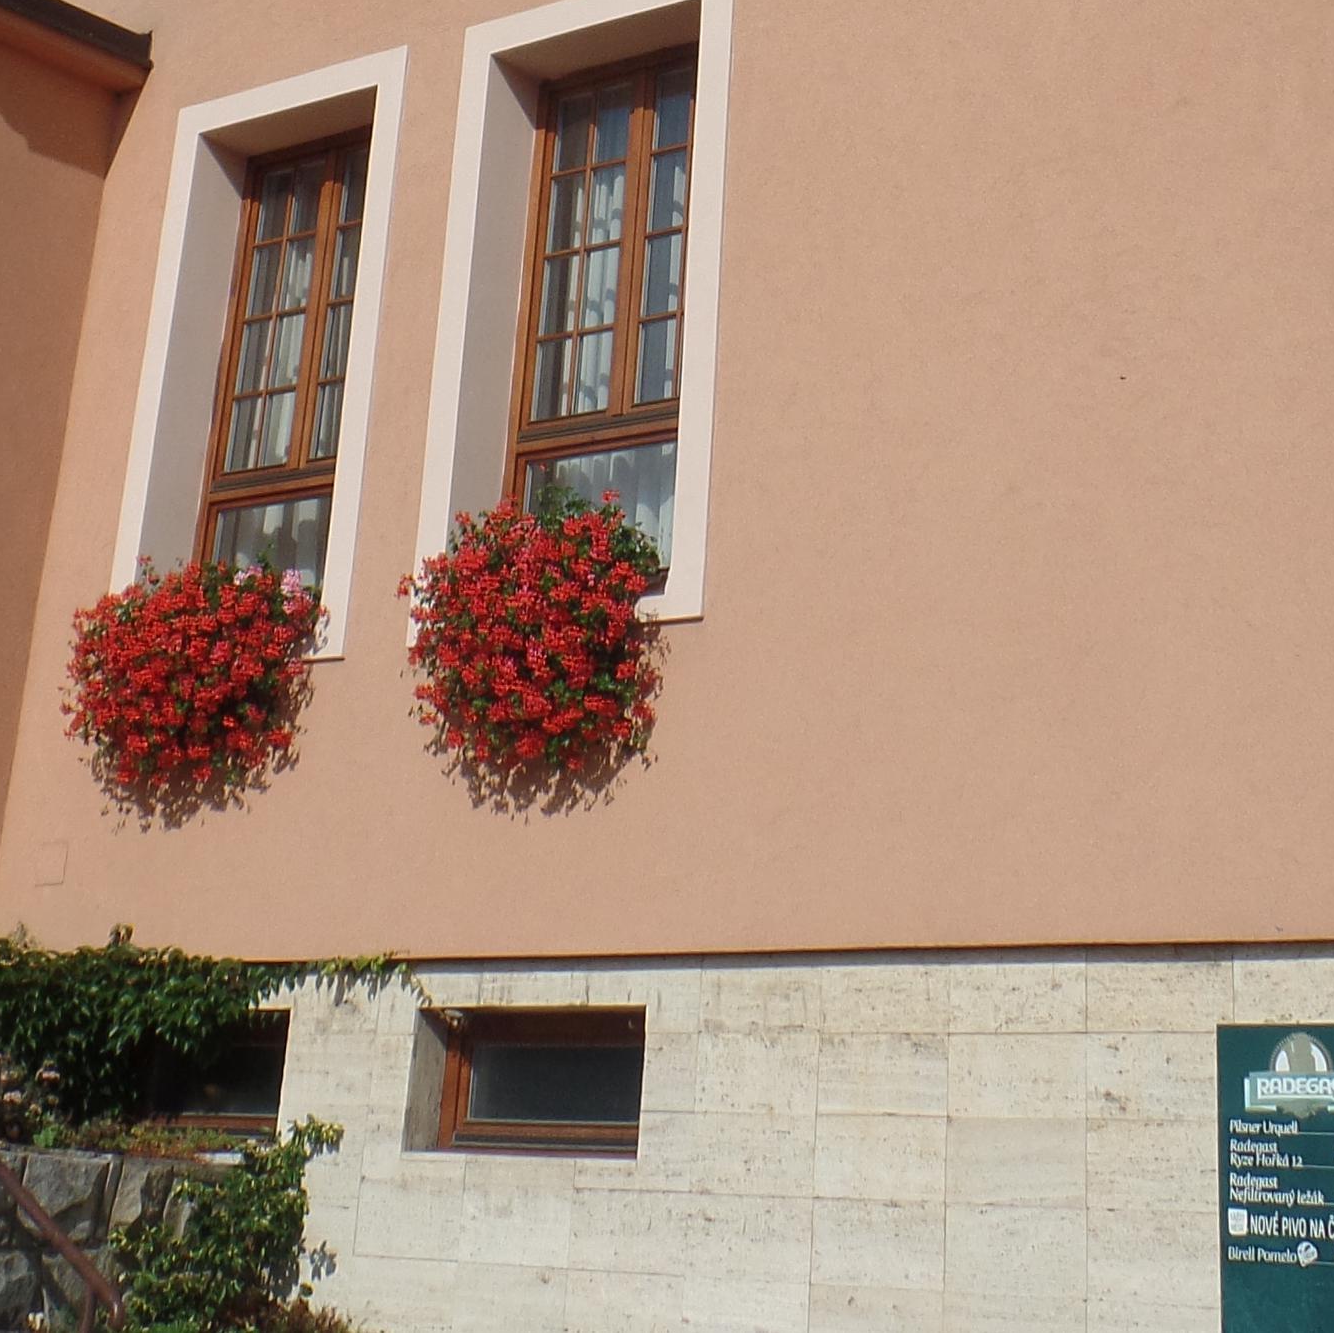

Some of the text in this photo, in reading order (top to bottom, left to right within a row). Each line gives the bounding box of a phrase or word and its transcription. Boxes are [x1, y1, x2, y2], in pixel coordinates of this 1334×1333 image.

[1229, 1118, 1299, 1138] Pilsner Urquell
[1229, 1138, 1278, 1156] Radegast
[1230, 1152, 1253, 1169] Ryze
[1291, 1156, 1303, 1167] 12
[1229, 1171, 1278, 1189] Radegast
[1229, 1187, 1295, 1208] Nefiltrovaný
[1250, 1210, 1279, 1236] NOVÉ
[1281, 1216, 1307, 1238] PIVO
[1310, 1218, 1326, 1240] NA
[1228, 1245, 1298, 1263] Birell Pomelo
